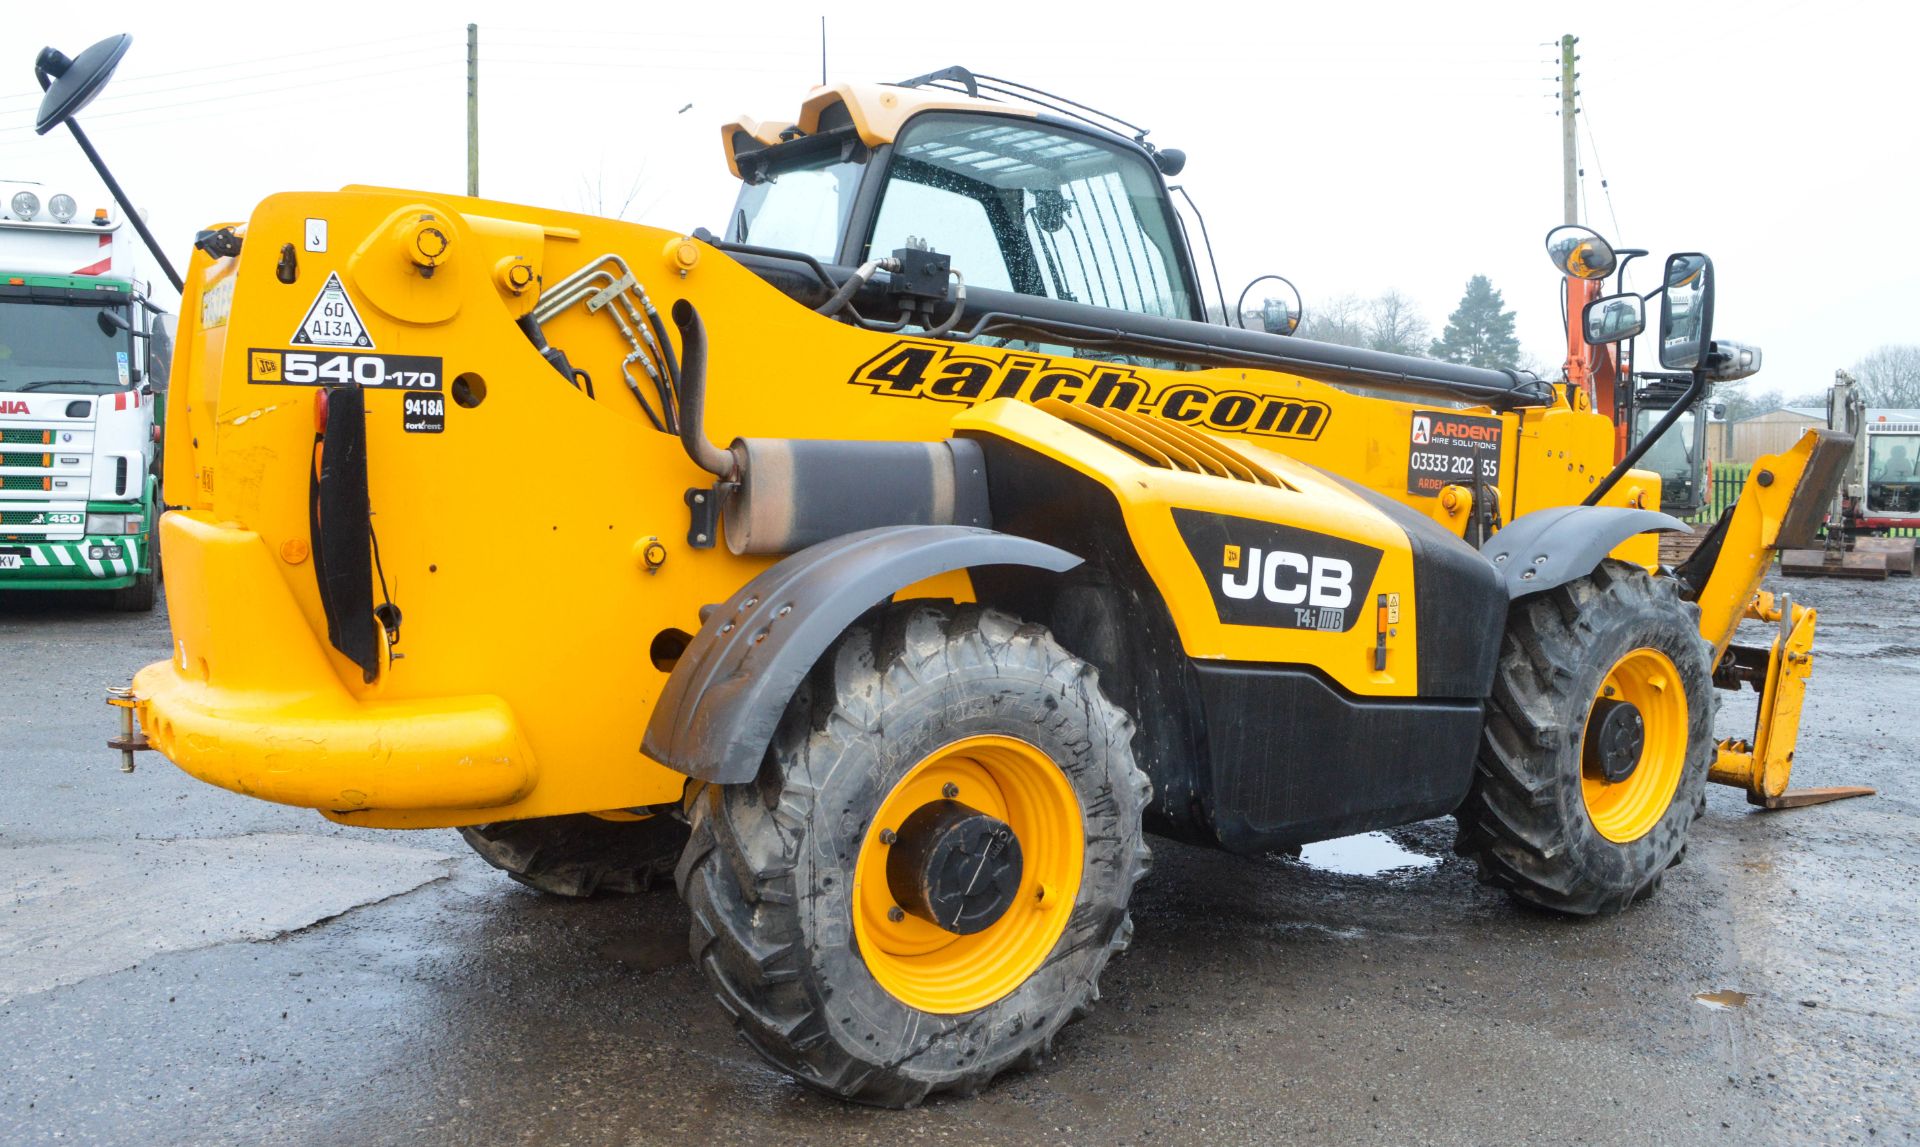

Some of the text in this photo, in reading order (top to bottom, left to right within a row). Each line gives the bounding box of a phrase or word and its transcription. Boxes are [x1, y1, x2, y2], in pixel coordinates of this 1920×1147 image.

[324, 302, 344, 317] 60
[259, 359, 277, 373] JCB
[405, 399, 444, 416] 9418A
[1433, 421, 1501, 442] ARDENT
[1431, 436, 1497, 450] HIRE SOLUTIONS
[1411, 451, 1497, 477] 03333 202 55
[49, 514, 81, 524] 420
[1222, 547, 1352, 609] JCB
[1294, 607, 1316, 628] T4i
